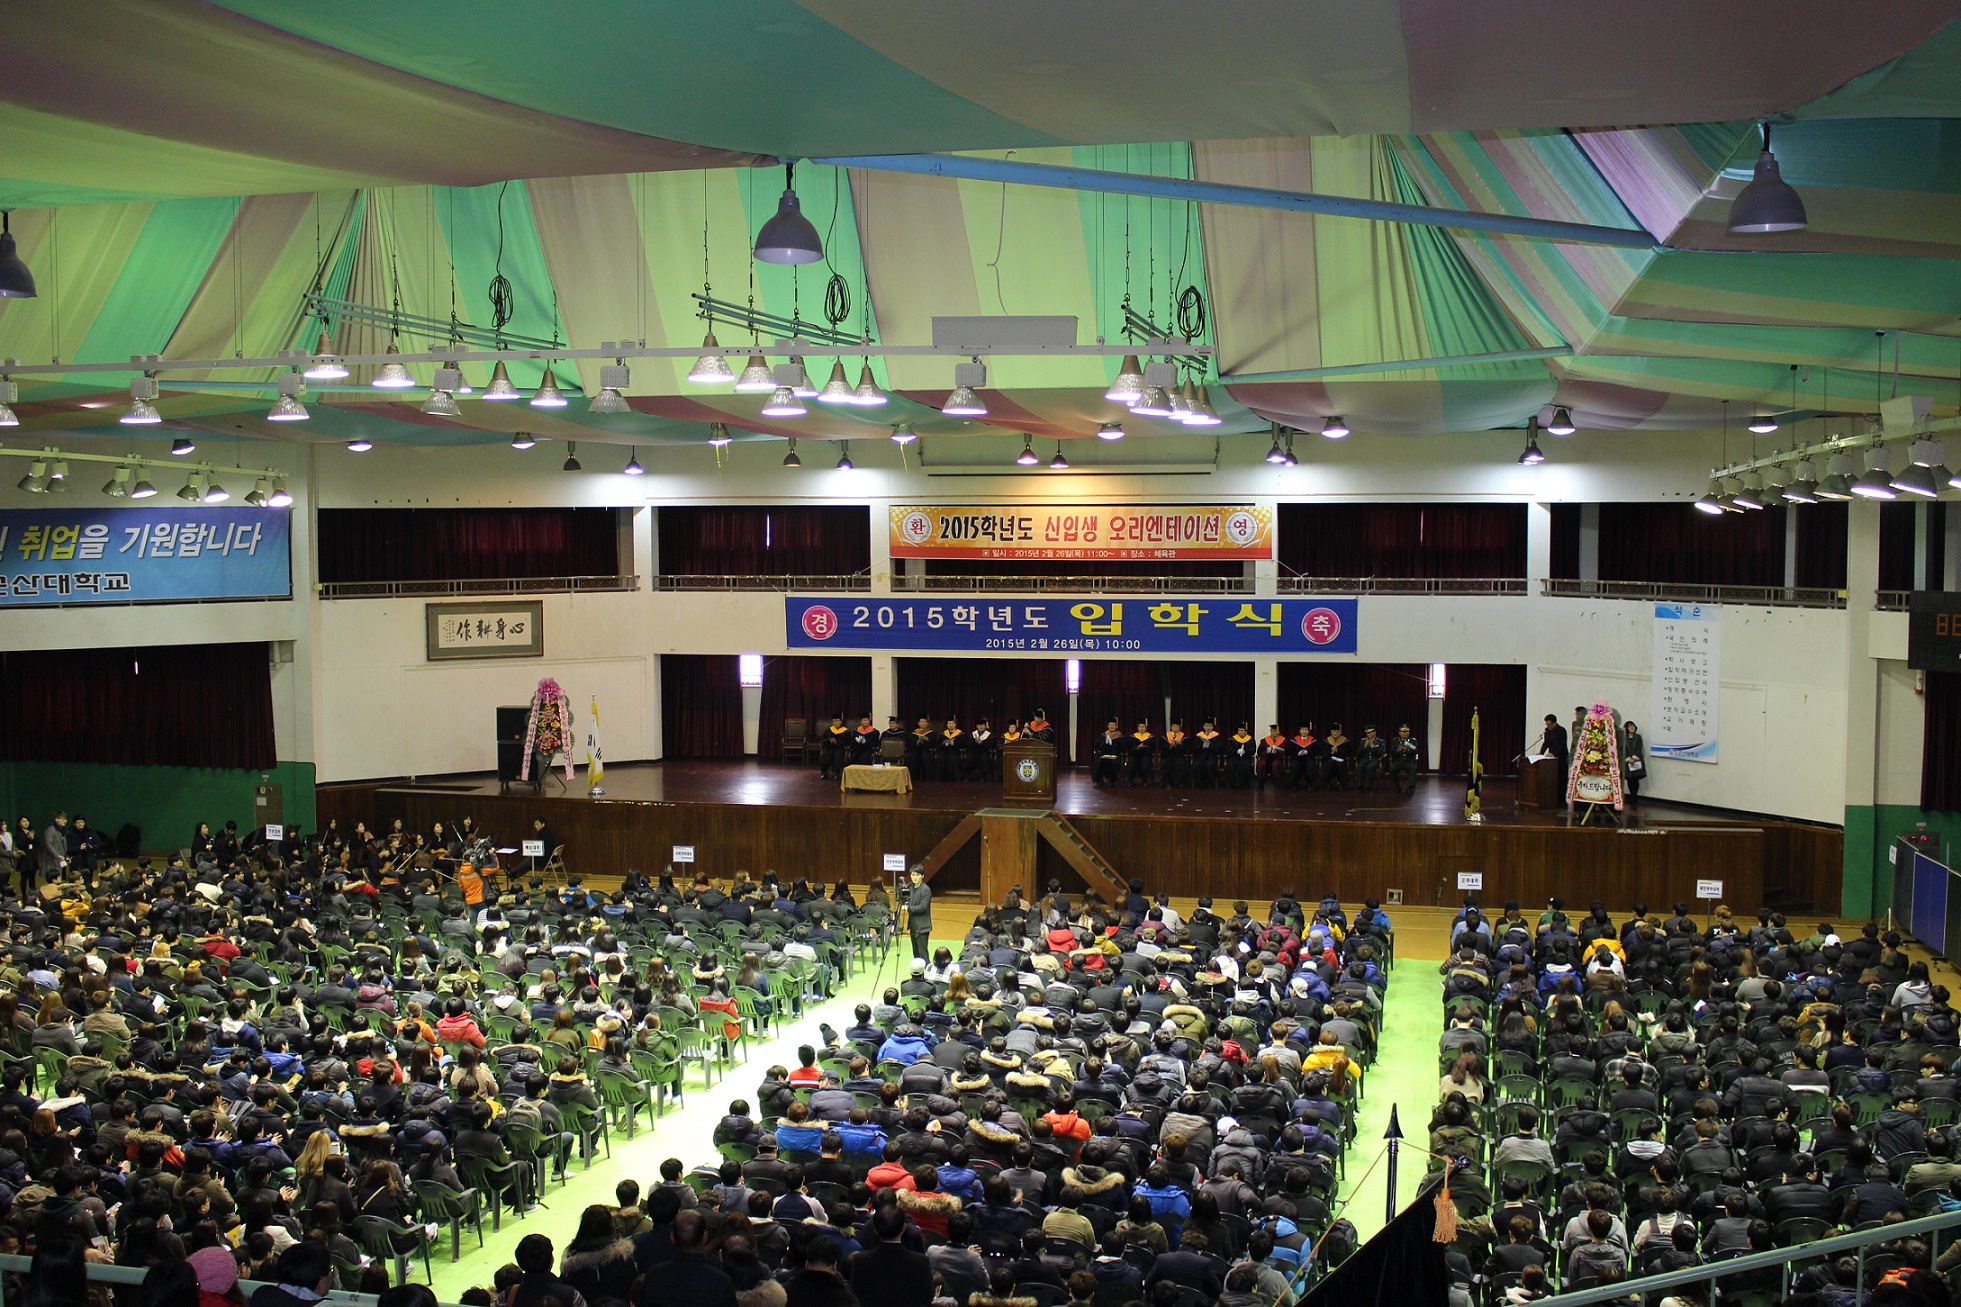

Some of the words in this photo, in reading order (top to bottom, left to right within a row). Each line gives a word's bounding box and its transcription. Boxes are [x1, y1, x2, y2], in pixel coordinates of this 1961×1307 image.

[940, 516, 1033, 542] 2015학년도
[1044, 516, 1098, 543] 신입생
[1109, 515, 1220, 542] 오리엔테이션
[18, 524, 109, 560] 취업을
[119, 522, 262, 558] 기원합니다
[1015, 549, 1040, 558] 2015년
[1041, 549, 1053, 558] 2월
[0, 571, 131, 598] 산대학교
[811, 613, 829, 634] 경
[853, 605, 1049, 631] 2015학년도
[1311, 615, 1331, 636] 축
[986, 638, 1025, 649] 2015년
[1030, 638, 1048, 649] 2월
[1053, 637, 1100, 650] 26일(목)
[1105, 639, 1140, 650] 10:00
